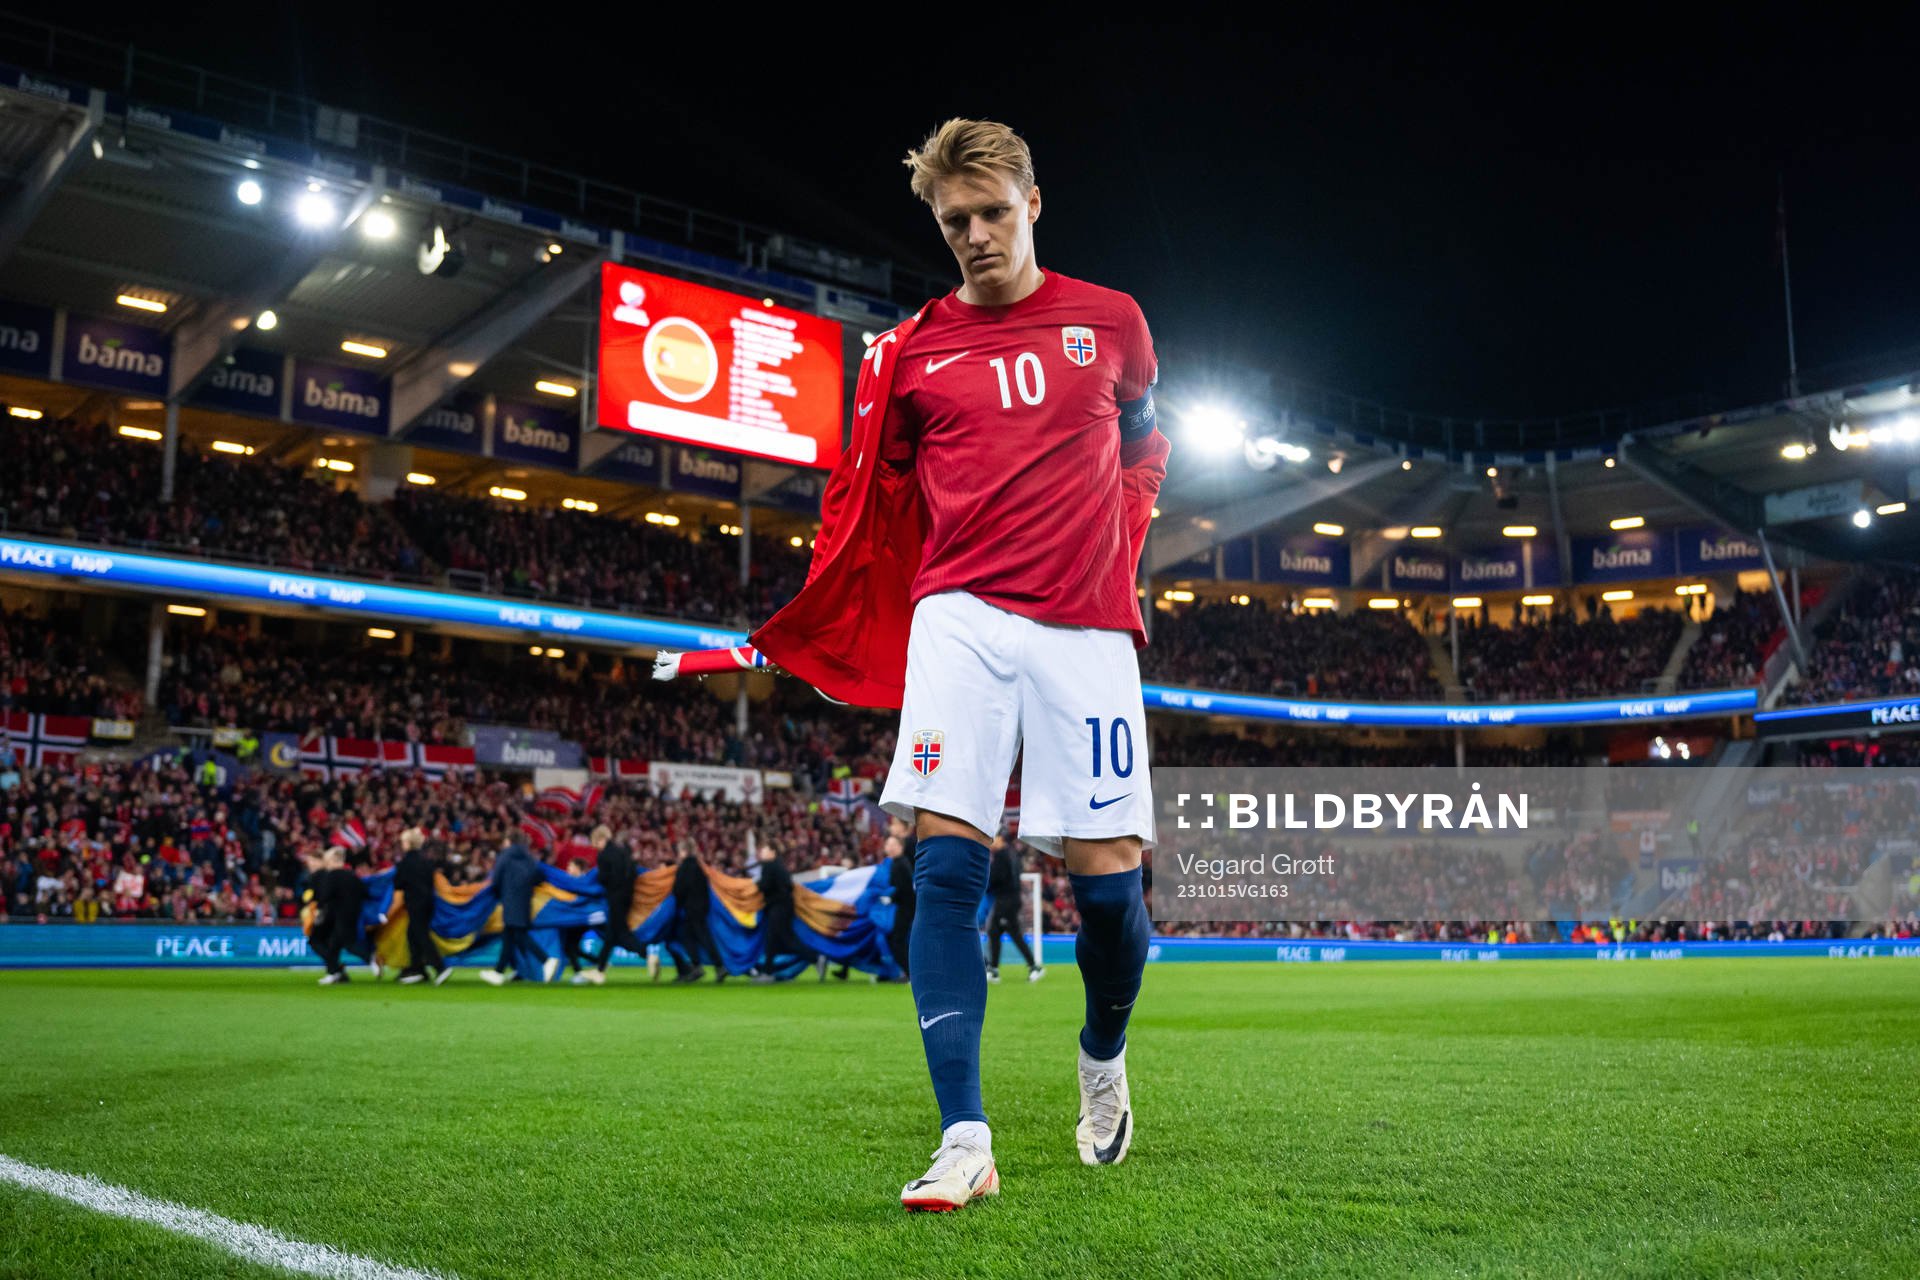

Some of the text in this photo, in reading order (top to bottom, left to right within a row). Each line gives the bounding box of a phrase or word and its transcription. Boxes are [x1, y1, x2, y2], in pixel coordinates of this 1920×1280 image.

[78, 334, 163, 377] bama
[989, 352, 1046, 409] 10
[303, 378, 380, 418] bama
[503, 416, 571, 453] bama
[679, 448, 738, 484] bama
[1, 545, 56, 568] PEACE
[1593, 547, 1653, 569] bama
[1701, 539, 1759, 561] bama
[1280, 550, 1331, 574] bama
[1395, 556, 1444, 580] bama
[1461, 560, 1517, 580] bama
[269, 577, 317, 599] PEACE
[1872, 704, 1920, 724] PEACE
[502, 740, 557, 766] bama
[155, 935, 235, 958] PEACE
[1277, 945, 1311, 961] PEACE
